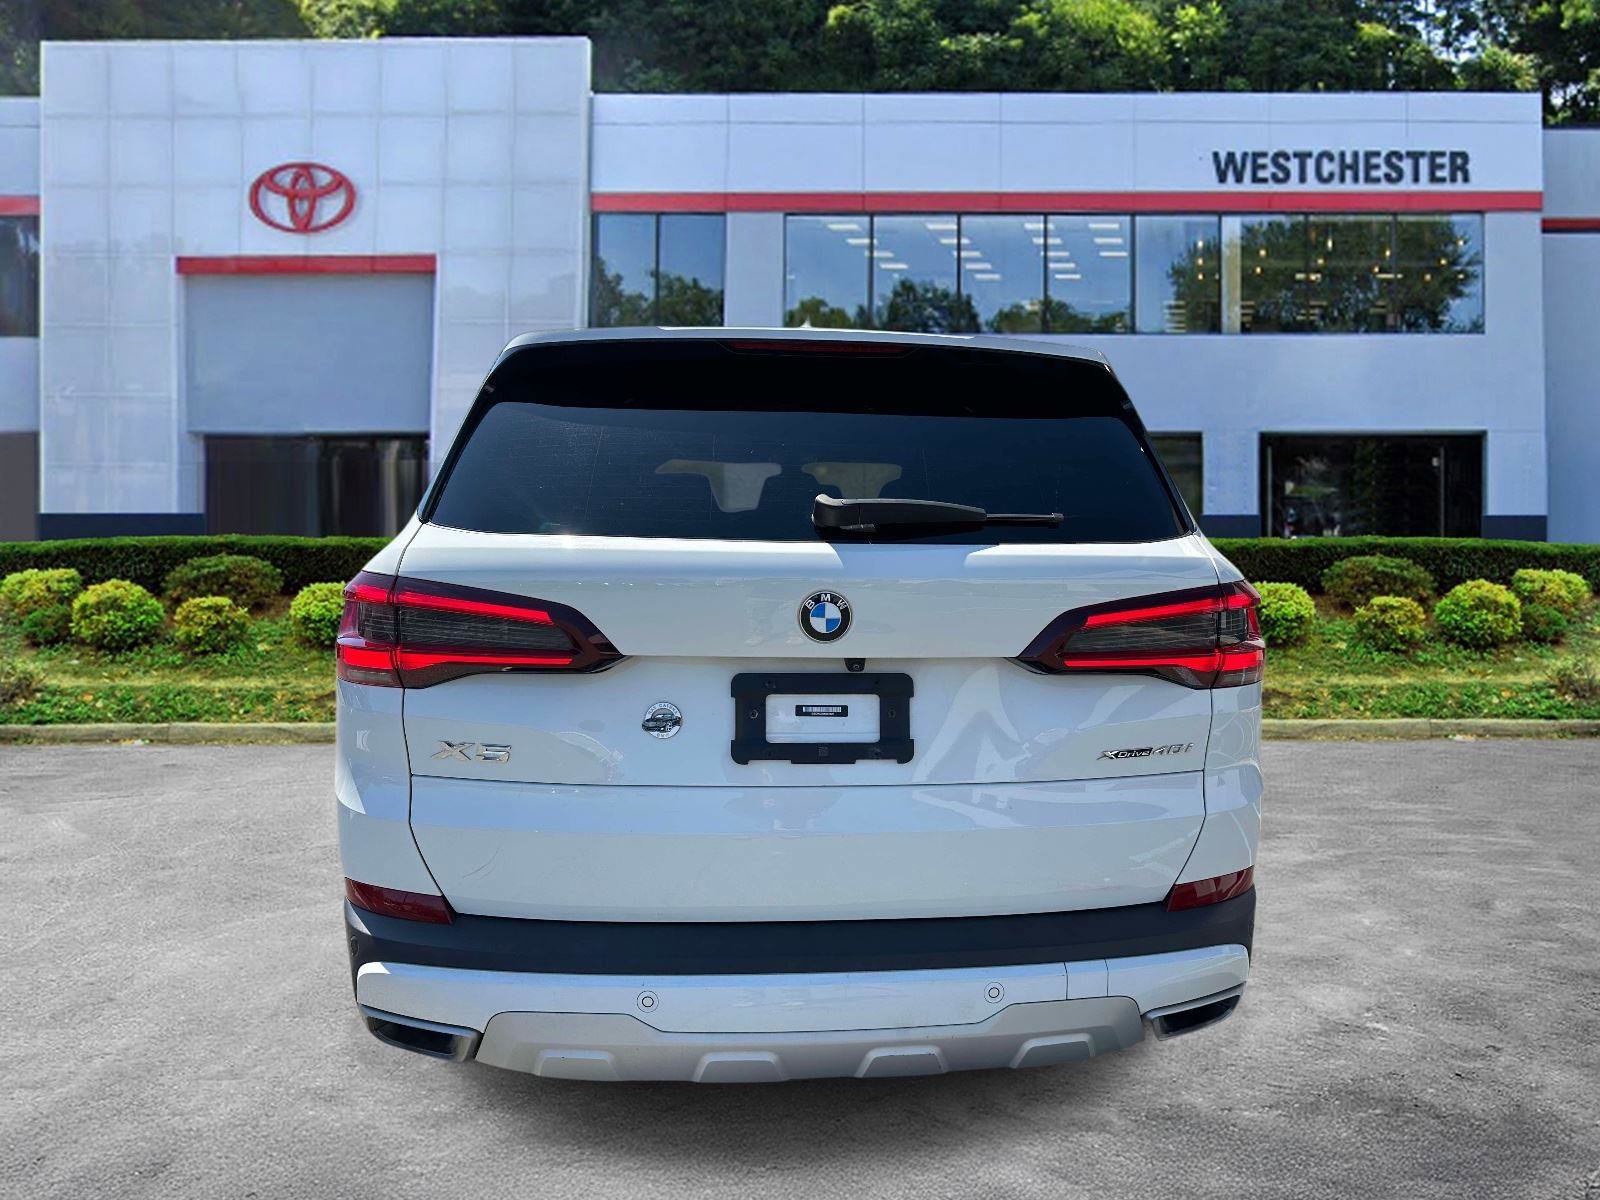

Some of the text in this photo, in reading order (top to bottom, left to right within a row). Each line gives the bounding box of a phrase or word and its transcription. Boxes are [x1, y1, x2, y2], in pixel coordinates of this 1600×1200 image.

[1212, 150, 1470, 184] WESTCHESTER
[804, 593, 847, 610] BMW
[430, 740, 511, 763] X5
